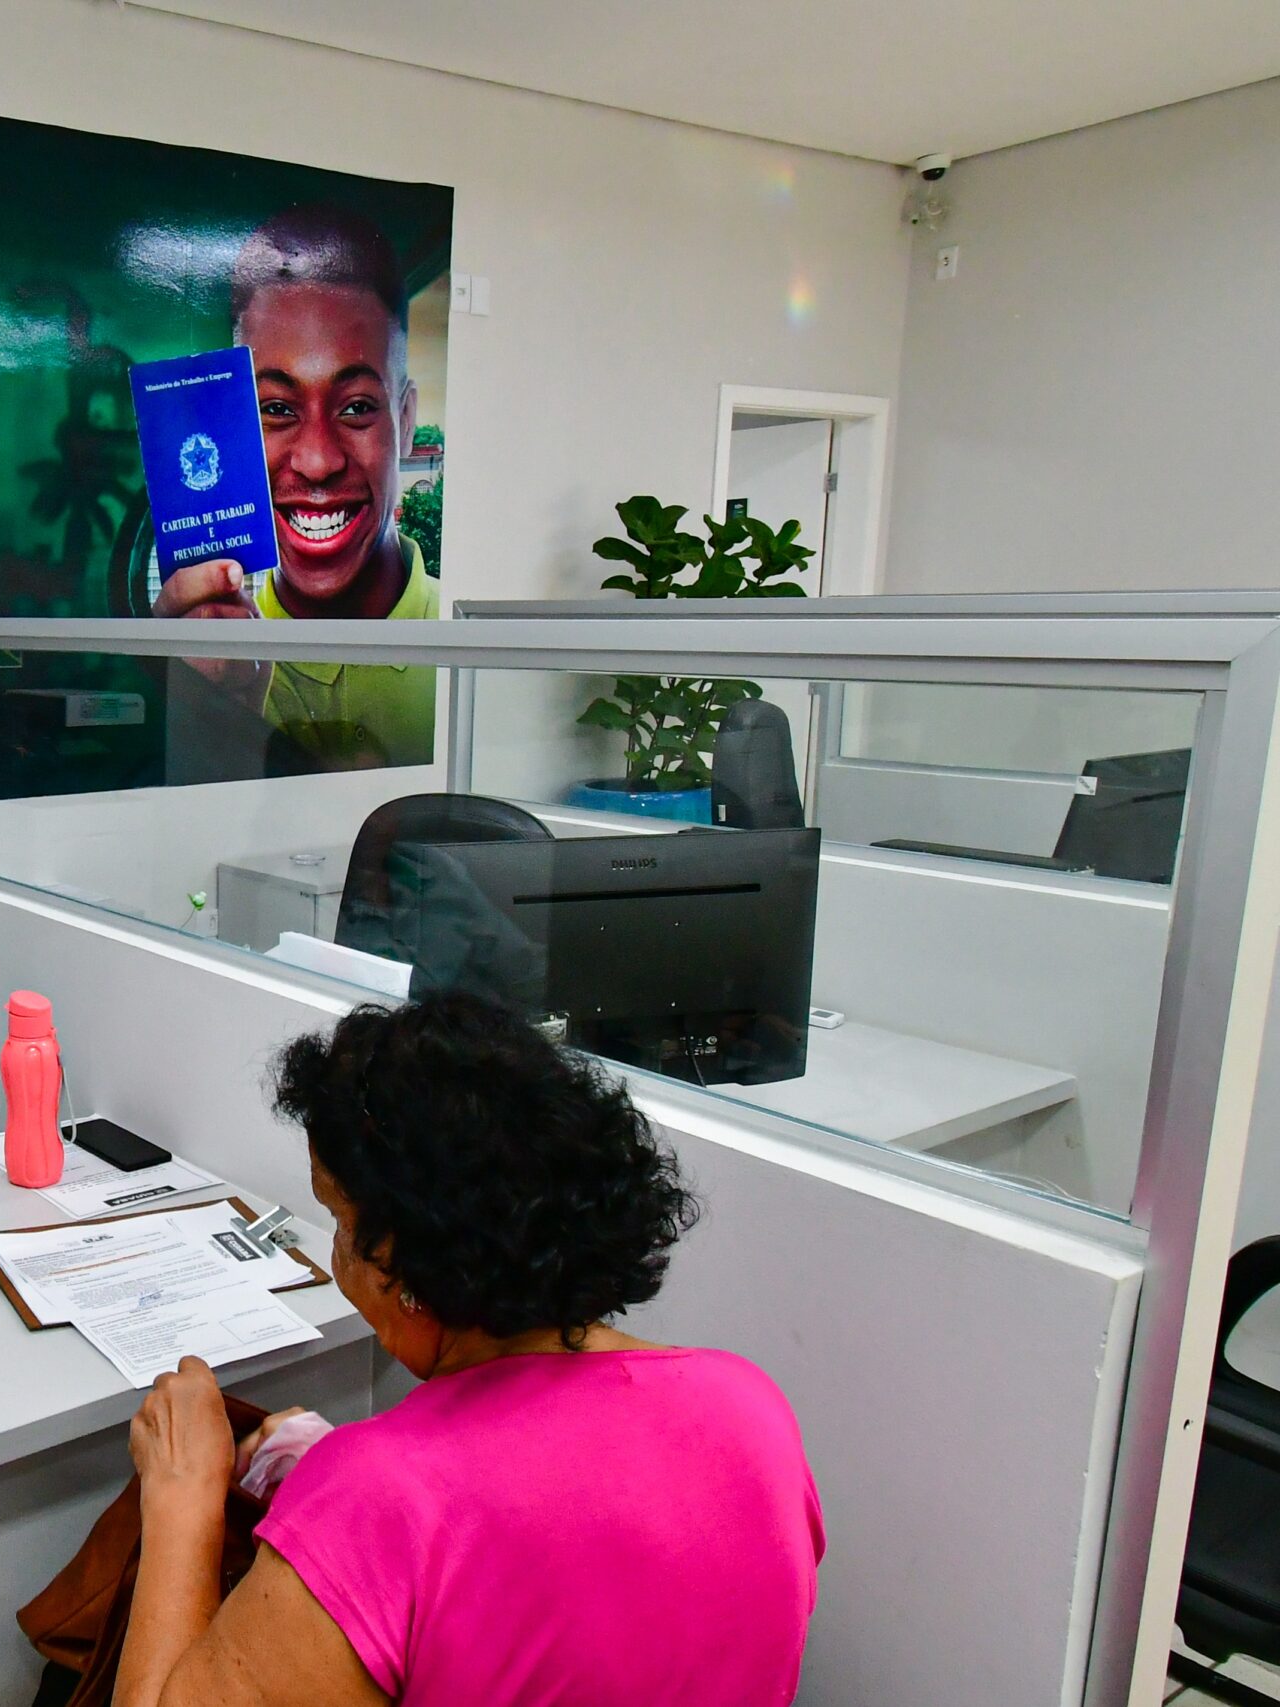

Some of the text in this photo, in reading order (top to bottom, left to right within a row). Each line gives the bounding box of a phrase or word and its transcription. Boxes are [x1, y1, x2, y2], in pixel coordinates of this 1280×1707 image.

[161, 502, 256, 533] CARTEIRA DE TRABALHO
[208, 527, 215, 538] E
[173, 533, 253, 561] PREVIDÊNCIA SOCIAL
